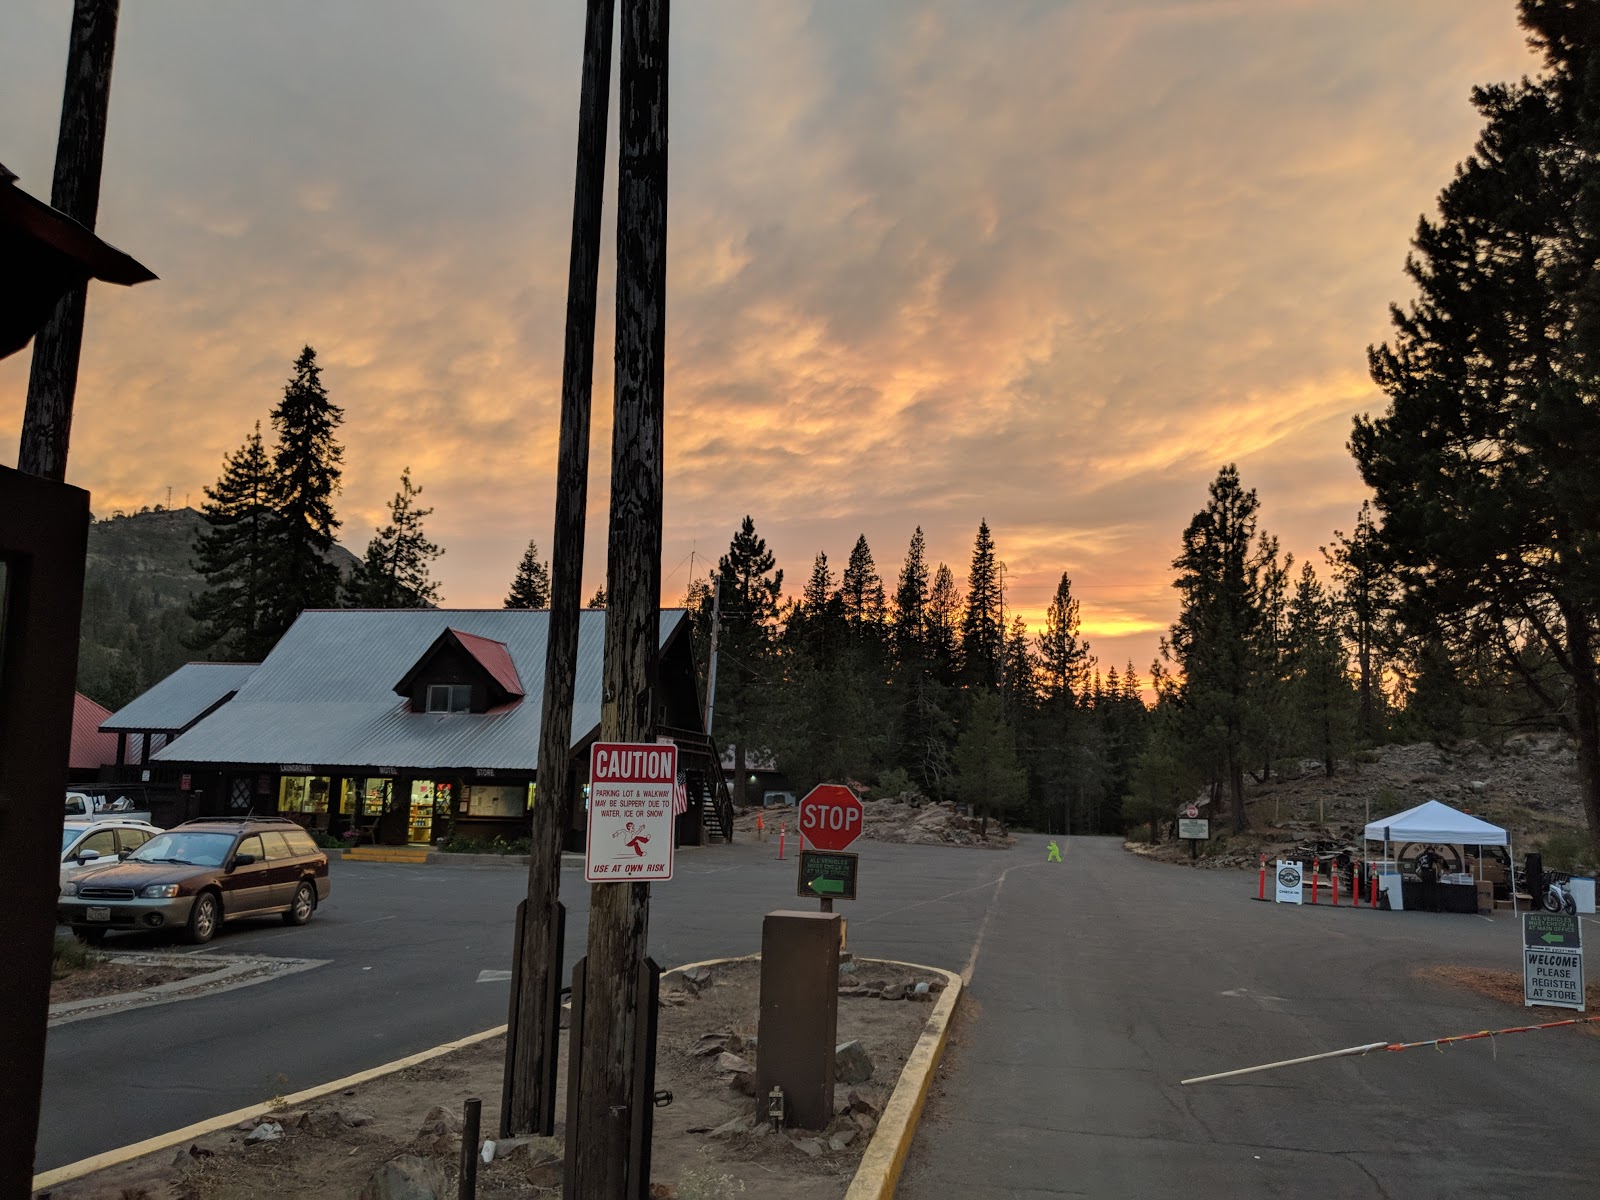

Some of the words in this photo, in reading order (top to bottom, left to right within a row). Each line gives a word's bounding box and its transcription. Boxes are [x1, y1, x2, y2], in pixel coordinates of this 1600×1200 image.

[596, 750, 672, 779] CAUTION
[379, 767, 398, 775] MOTEL
[476, 768, 495, 777] STORE
[596, 790, 620, 798] PARKING
[643, 790, 670, 798] WALKWAY
[595, 799, 606, 807] MAY
[601, 810, 622, 818] WATER,
[803, 804, 859, 831] STOP
[594, 865, 609, 873] USE
[625, 864, 643, 872] OWN
[647, 864, 666, 872] RISK
[1528, 954, 1578, 967] WELCOME
[1537, 967, 1571, 978] PLEASE
[1532, 978, 1577, 990] REGISTER
[1533, 988, 1543, 997] AT
[1546, 989, 1577, 1001] STORE
